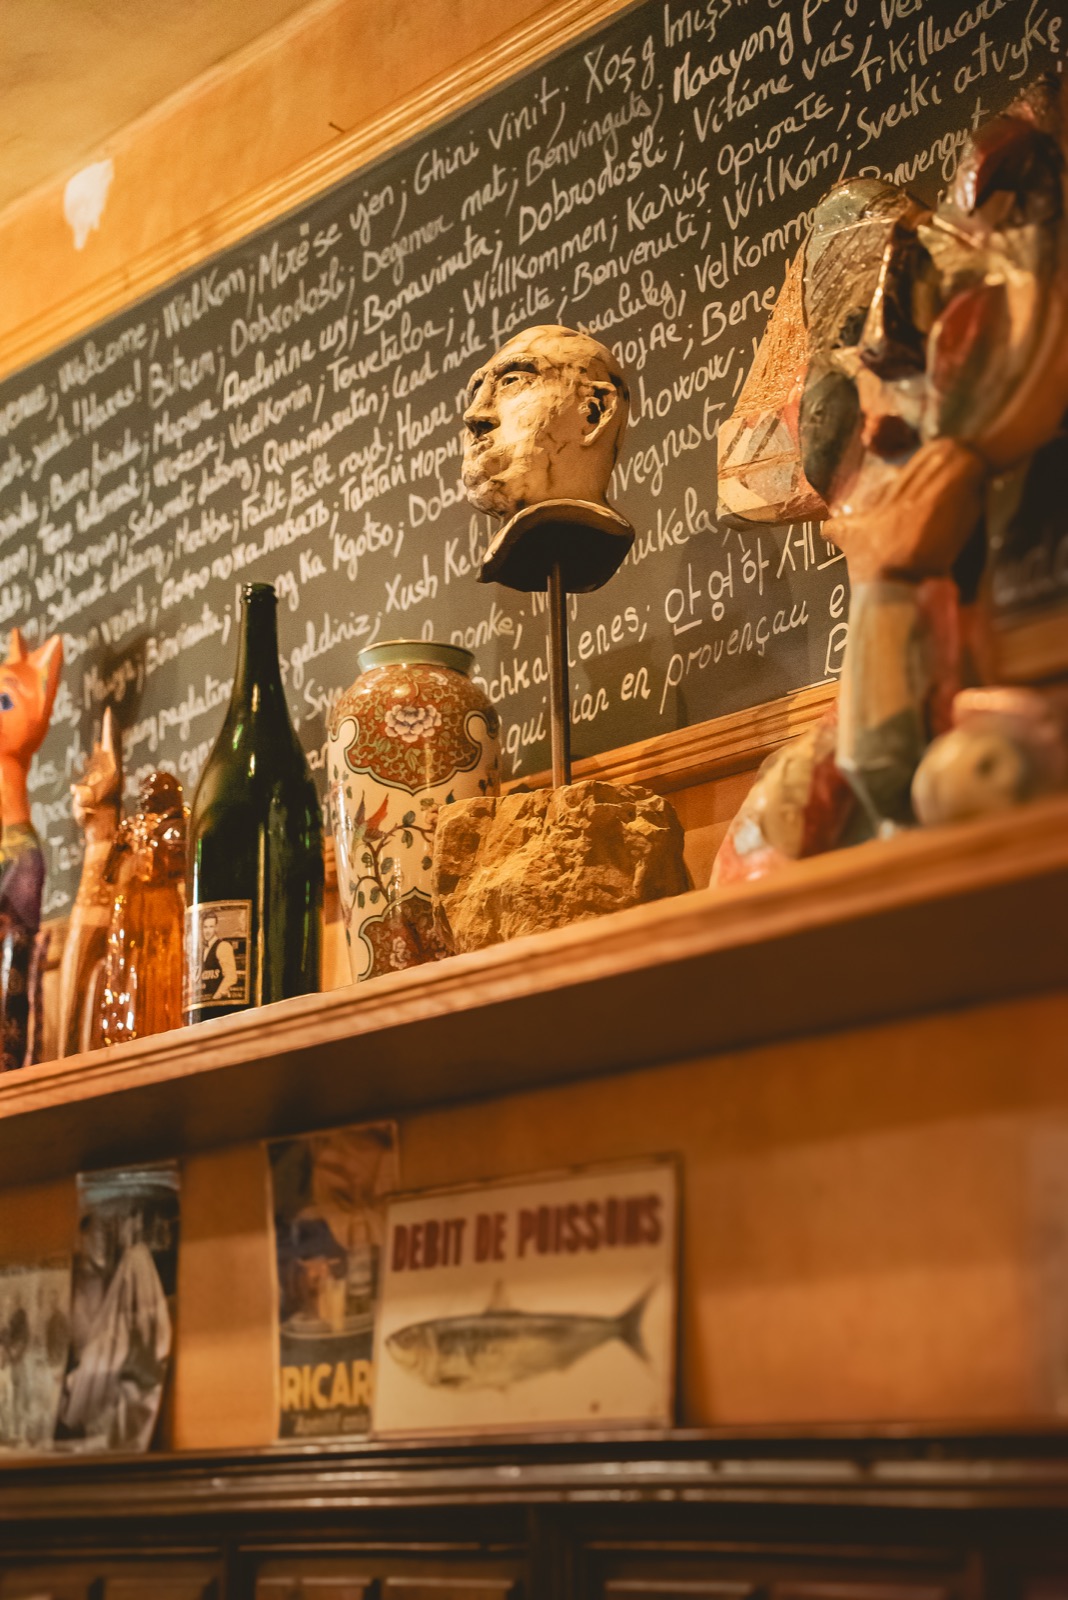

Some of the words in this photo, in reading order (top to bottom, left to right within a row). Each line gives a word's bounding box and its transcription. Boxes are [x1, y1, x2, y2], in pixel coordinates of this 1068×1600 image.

[857, 71, 942, 150] Sveiki
[413, 130, 480, 196] Ghini
[385, 554, 440, 613] Xush
[620, 667, 651, 701] en
[474, 1212, 507, 1263] DE
[517, 1194, 663, 1258] POISSONS
[280, 1360, 372, 1410] RICAR
